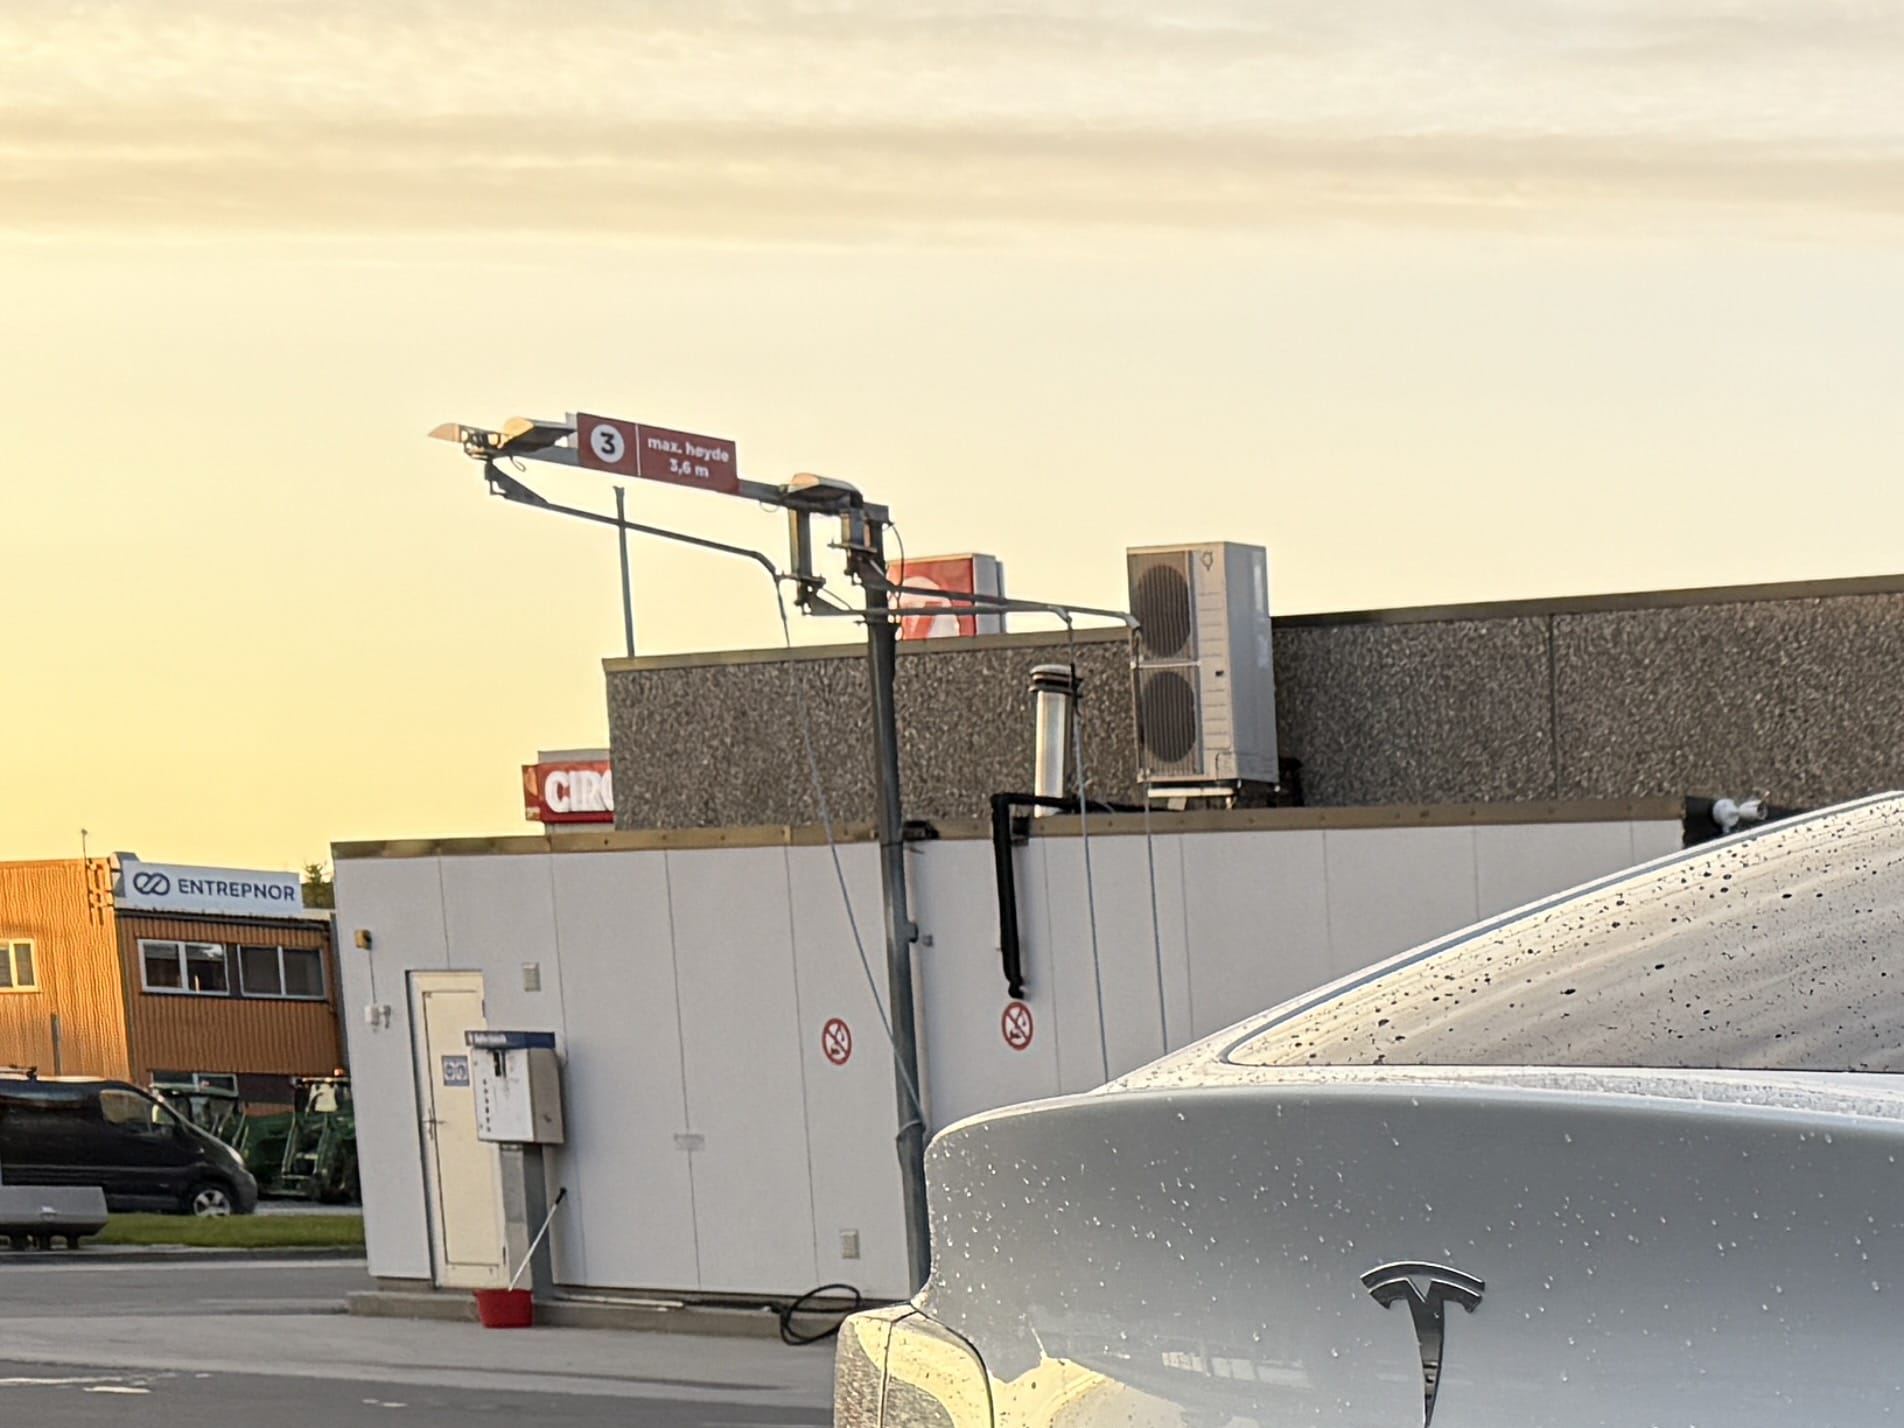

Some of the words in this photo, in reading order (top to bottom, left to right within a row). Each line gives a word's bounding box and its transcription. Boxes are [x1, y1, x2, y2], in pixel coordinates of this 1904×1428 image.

[600, 431, 617, 455] 3
[647, 437, 683, 454] max.
[685, 441, 730, 463] høyde
[669, 458, 692, 475] 3,6
[694, 465, 710, 479] m
[177, 878, 296, 901] ENTREPNOR
